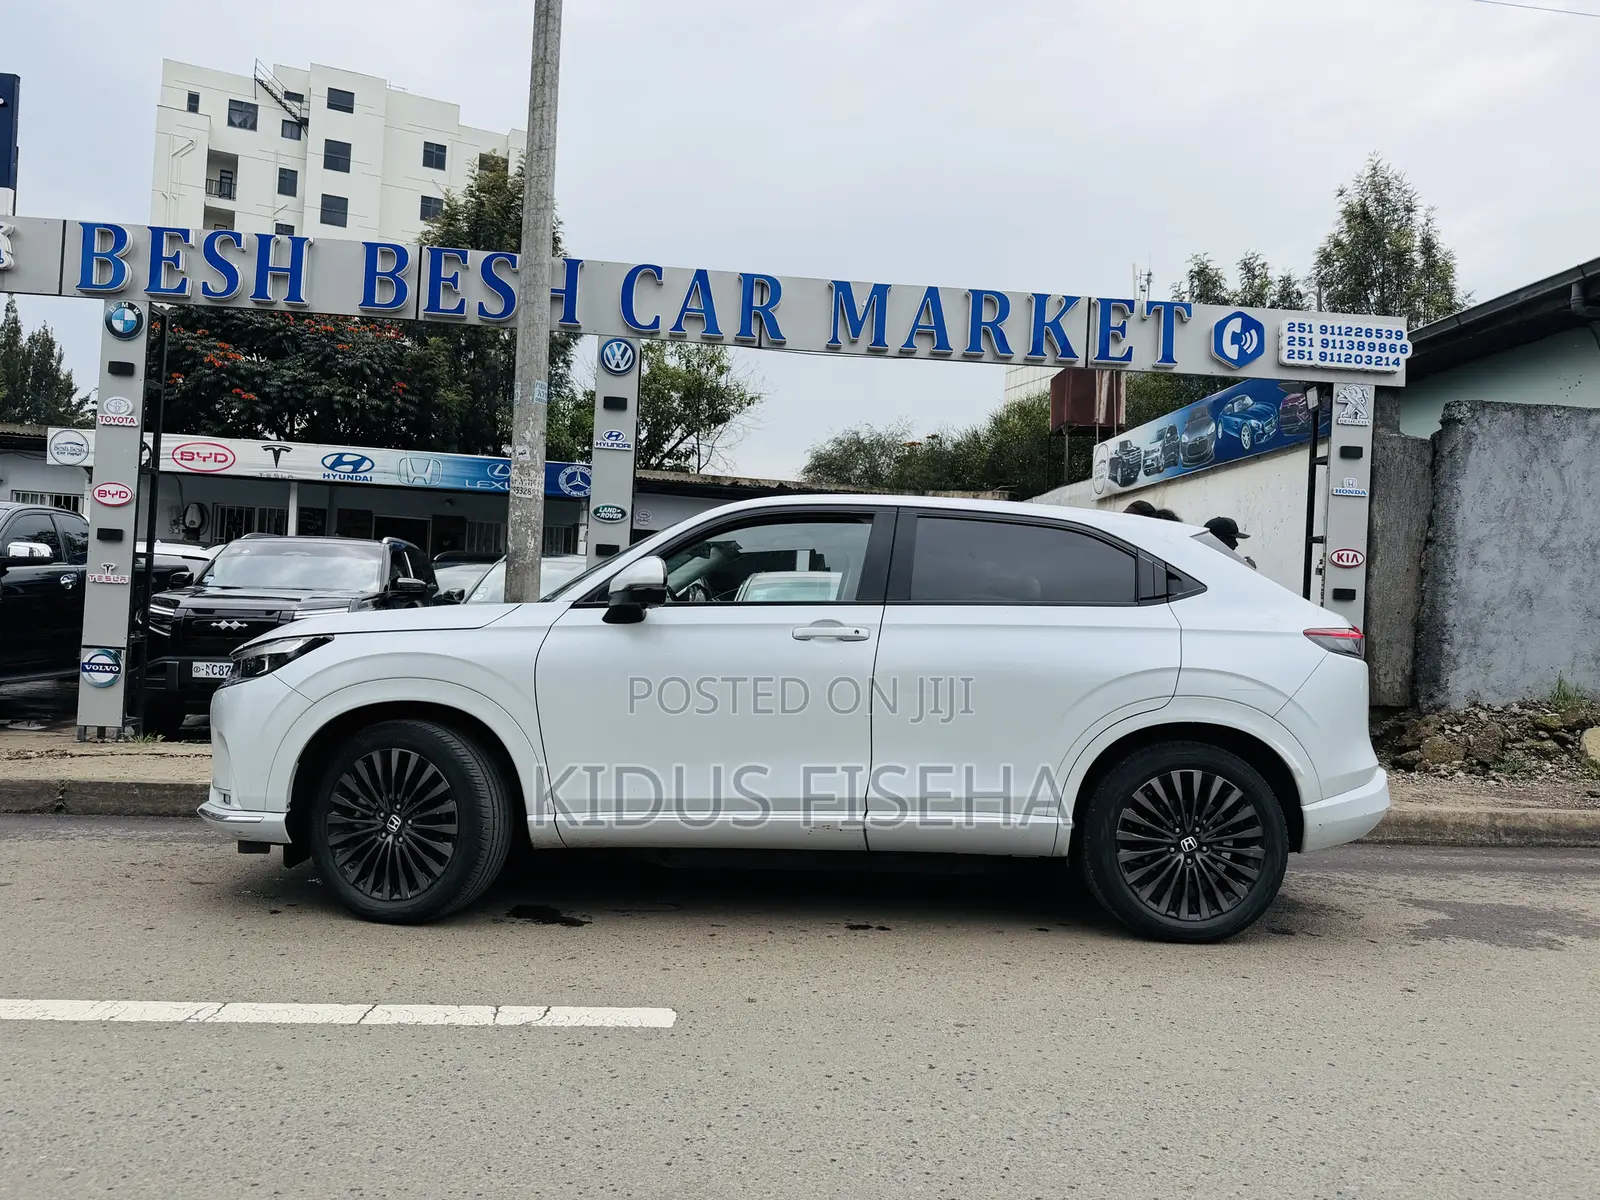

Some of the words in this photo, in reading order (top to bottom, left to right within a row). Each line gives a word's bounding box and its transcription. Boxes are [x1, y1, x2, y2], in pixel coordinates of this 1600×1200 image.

[76, 222, 312, 307] BESH
[619, 264, 786, 344] CAR
[828, 280, 1193, 368] MARKET
[109, 302, 140, 315] BMW
[1287, 322, 1314, 334] 251
[1320, 325, 1404, 340] 911226539
[1287, 336, 1314, 347] 251
[1320, 338, 1408, 354] 911389866
[1287, 349, 1314, 360] 251
[1319, 351, 1401, 367] 911203214
[99, 415, 136, 425] TOYOTA
[595, 441, 631, 449] HYUNDAI
[180, 451, 229, 463] BYD
[322, 472, 373, 482] HYUNDAI
[465, 480, 510, 490] LEX
[97, 489, 129, 499] BYD
[1336, 552, 1359, 564] KIA
[89, 574, 129, 583] TESLA
[84, 664, 119, 672] VOLVO
[211, 664, 231, 676] C87
